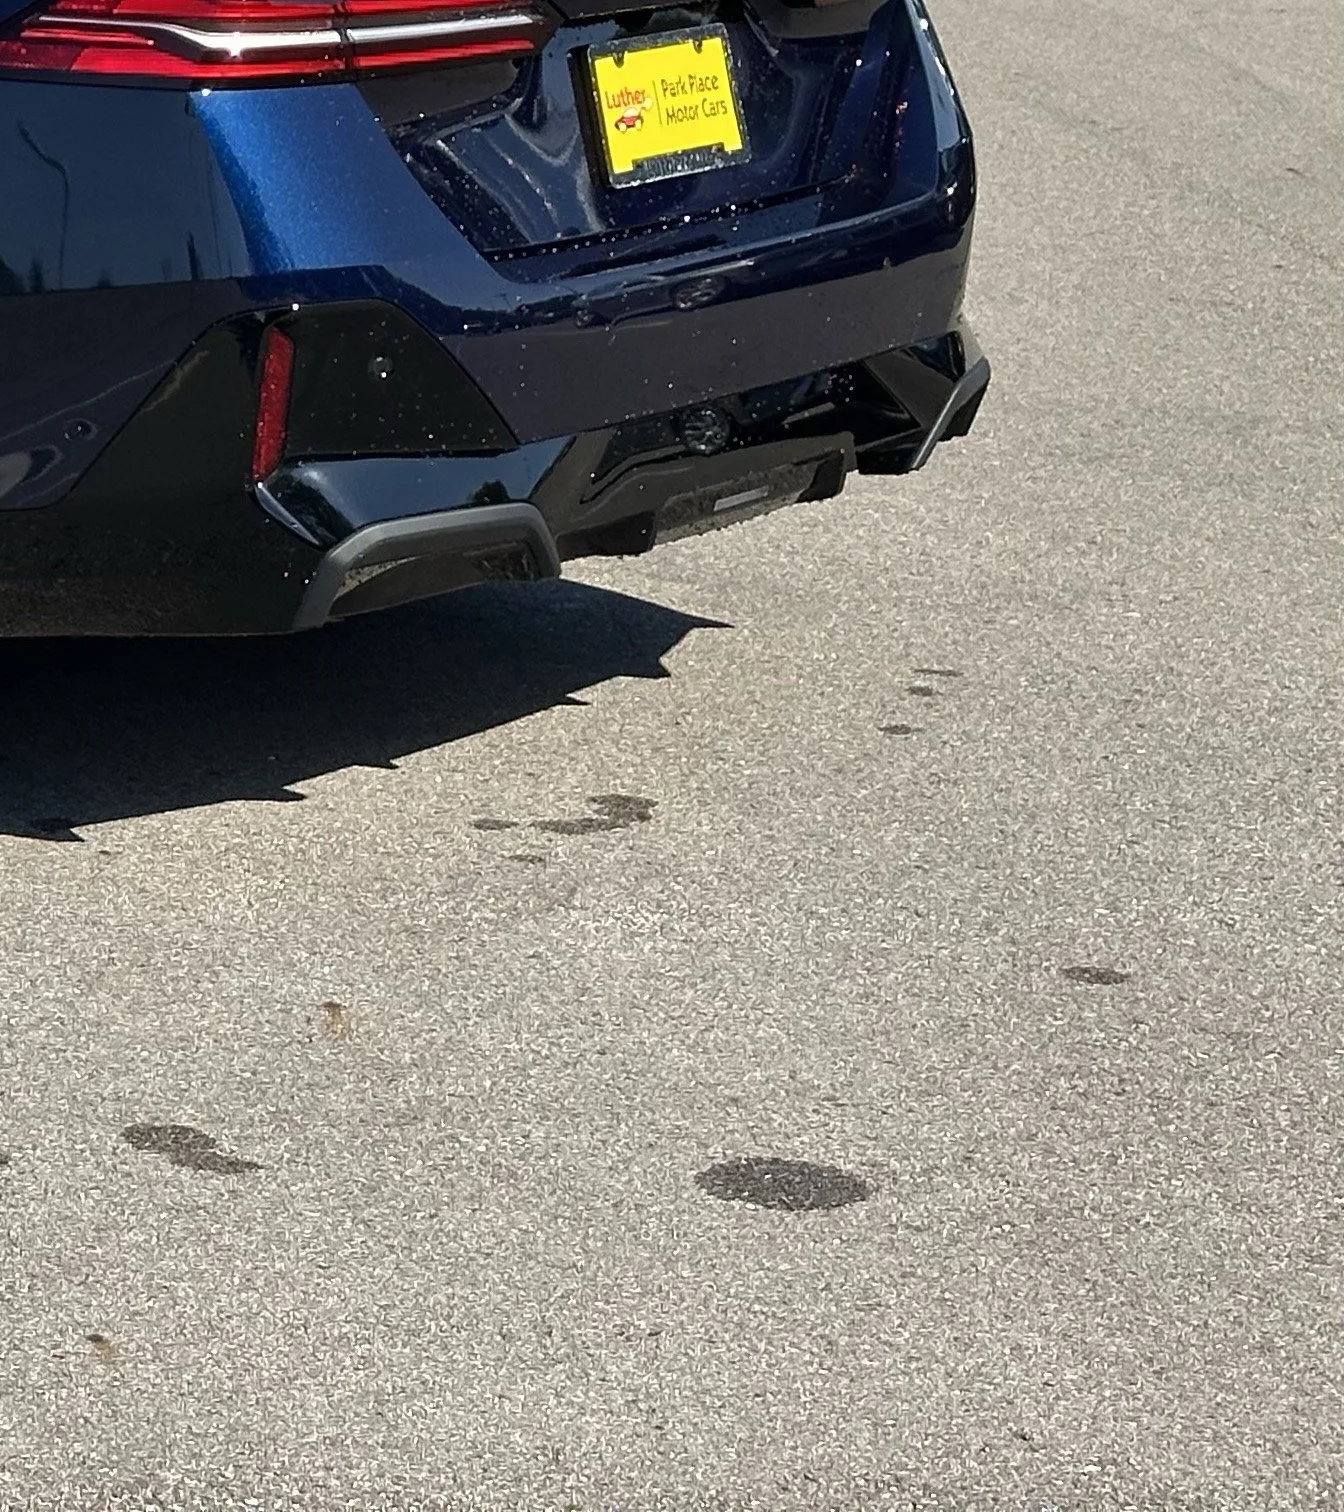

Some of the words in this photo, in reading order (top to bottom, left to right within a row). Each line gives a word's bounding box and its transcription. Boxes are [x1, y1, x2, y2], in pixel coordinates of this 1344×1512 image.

[604, 86, 647, 110] Luther
[661, 75, 688, 99] Park
[688, 73, 720, 95] Place
[665, 104, 700, 126] Motor
[701, 97, 729, 118] Cars
